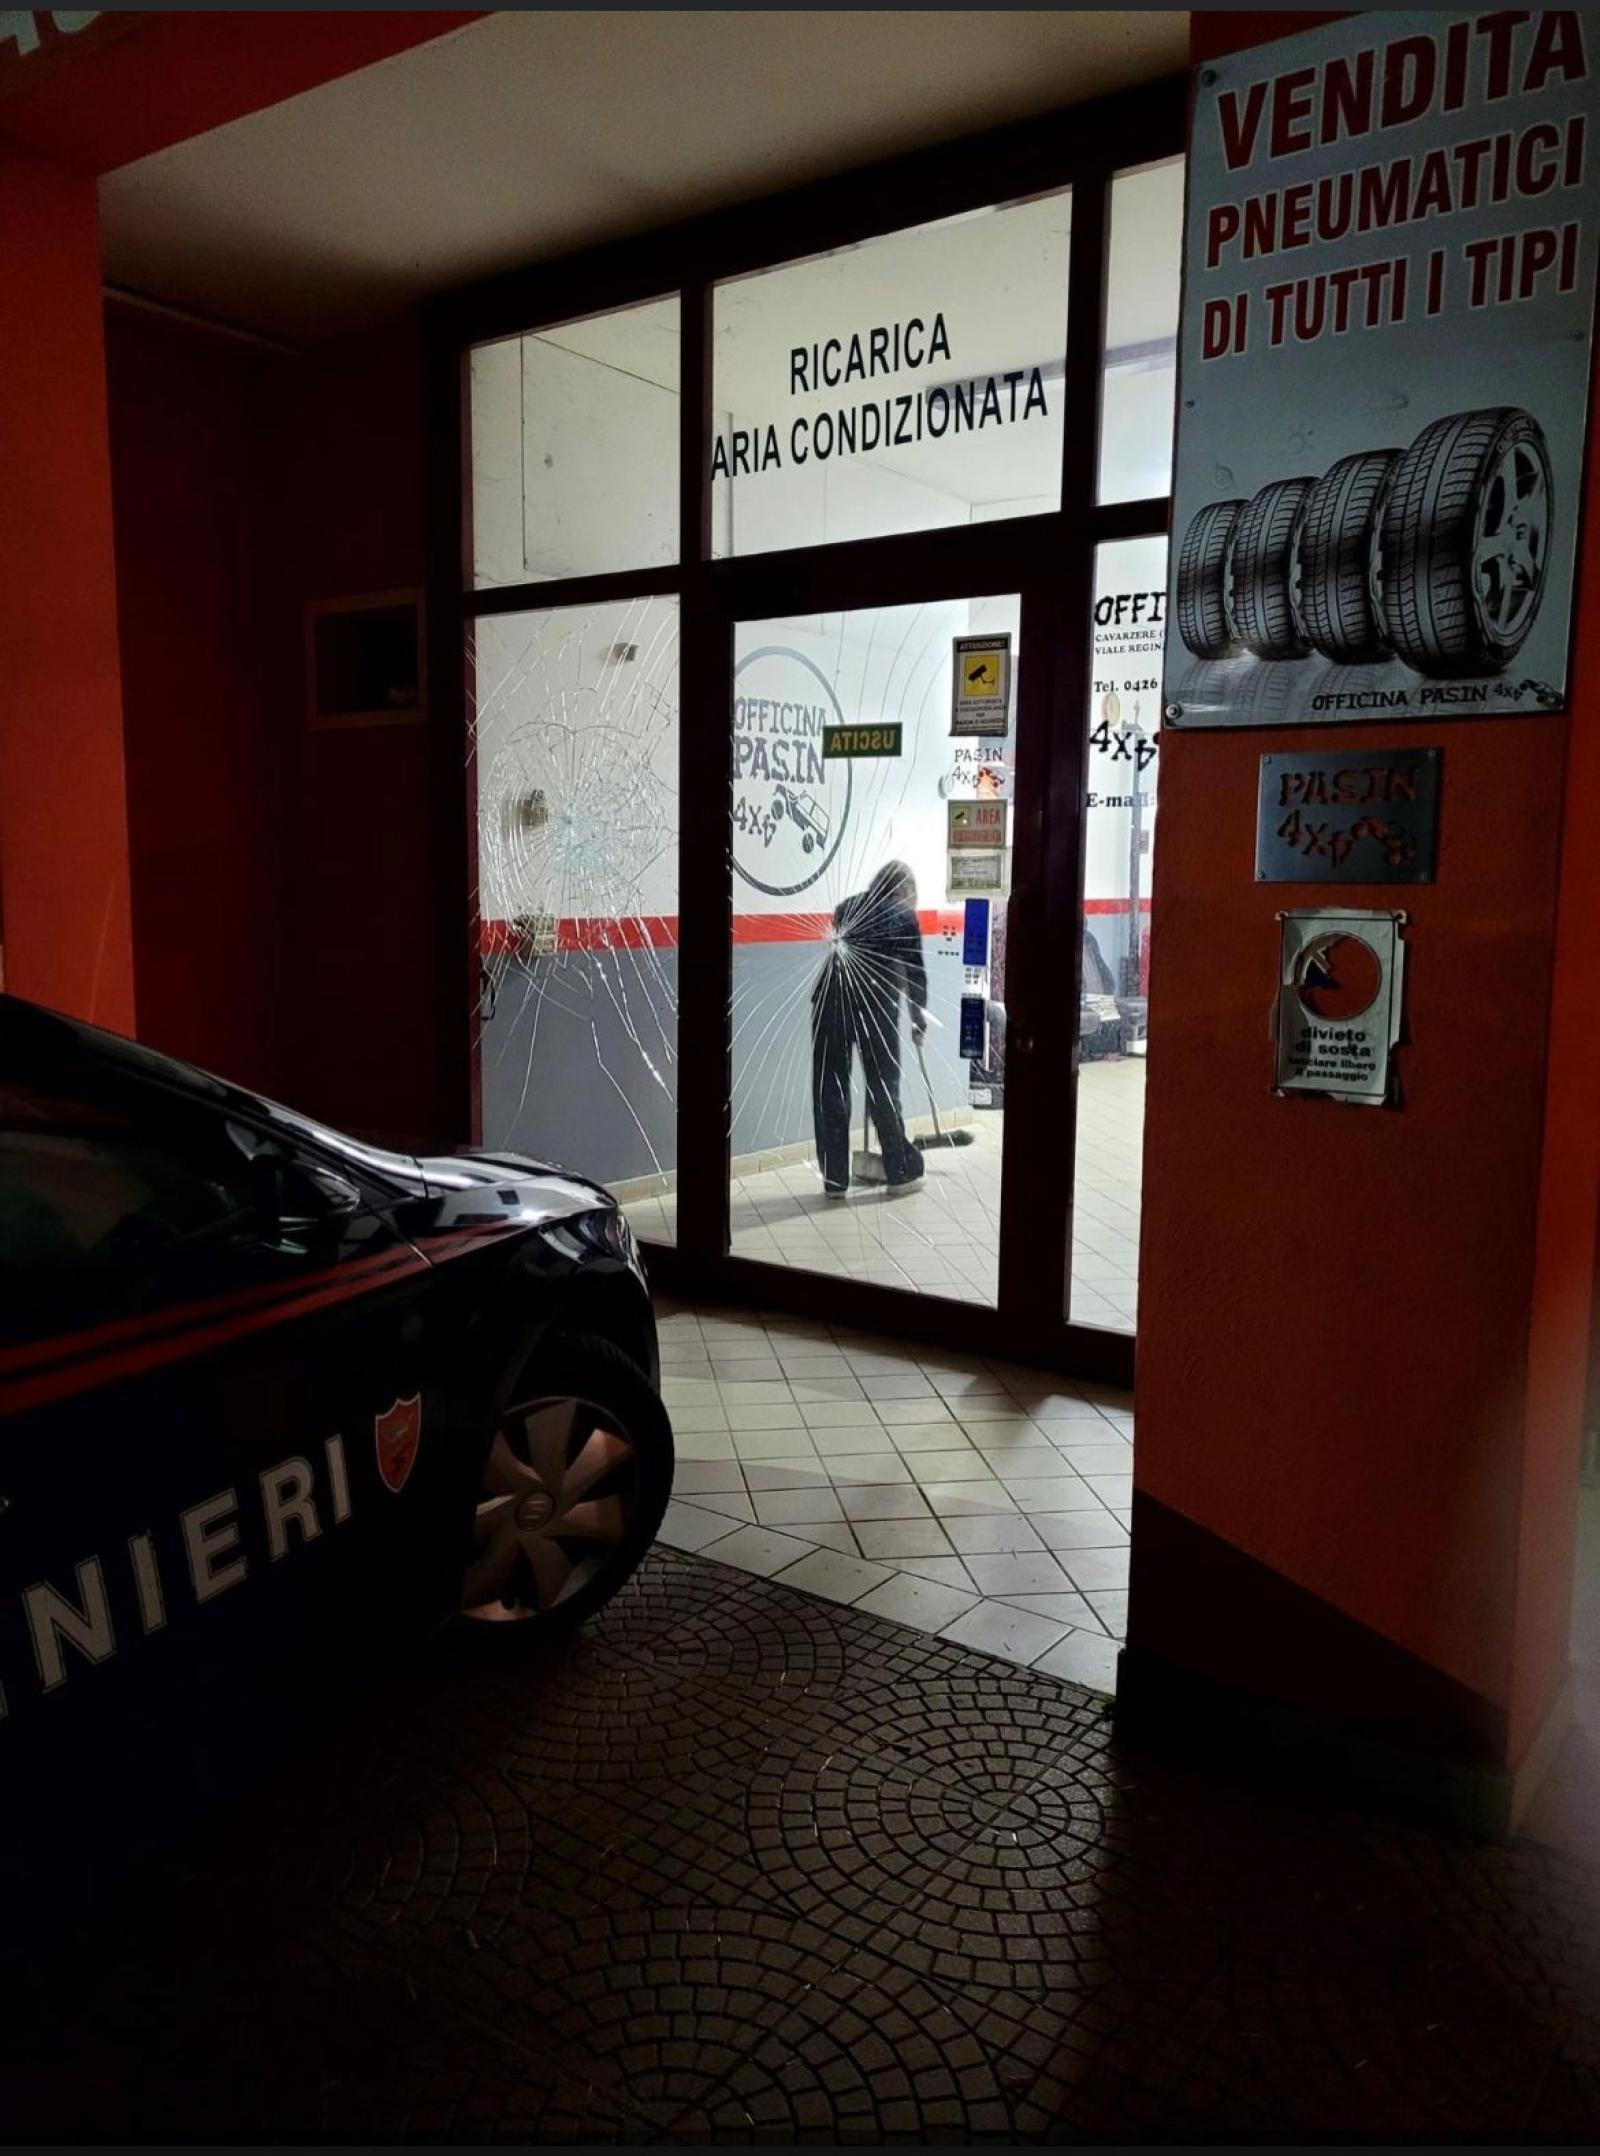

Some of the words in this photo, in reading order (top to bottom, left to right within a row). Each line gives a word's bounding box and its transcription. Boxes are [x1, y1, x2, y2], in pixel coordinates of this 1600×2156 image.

[1217, 10, 1588, 170] VENDITA
[1206, 116, 1586, 268] PNEUMATICI
[1203, 291, 1248, 361] DI
[1265, 258, 1408, 346] TUTTI
[1427, 249, 1445, 316] I
[1464, 222, 1580, 308] TIPI
[791, 312, 951, 394] RICARICA
[711, 424, 782, 480] ARIA
[791, 367, 1048, 465] CONDIZIONATA
[1094, 645, 1126, 655] VIALE
[1128, 642, 1164, 653] REGIN
[1095, 629, 1157, 642] CAVARZERE
[1094, 680, 1119, 692] Tel.
[1123, 677, 1158, 692] 0426
[1311, 690, 1410, 711] OFFICINA
[1420, 684, 1488, 704] PASIN
[733, 696, 827, 736] OFFICINA
[733, 735, 826, 785] PASIN
[954, 746, 1004, 763] PASIN
[1278, 765, 1418, 806] PASIN
[1295, 1039, 1312, 1054] di
[1318, 1043, 1372, 1058] sosta
[1301, 1025, 1366, 1042] divieto
[1306, 1069, 1369, 1082] passaggio
[1340, 1058, 1377, 1071] libero
[0, 1433, 352, 1718] NIERI
